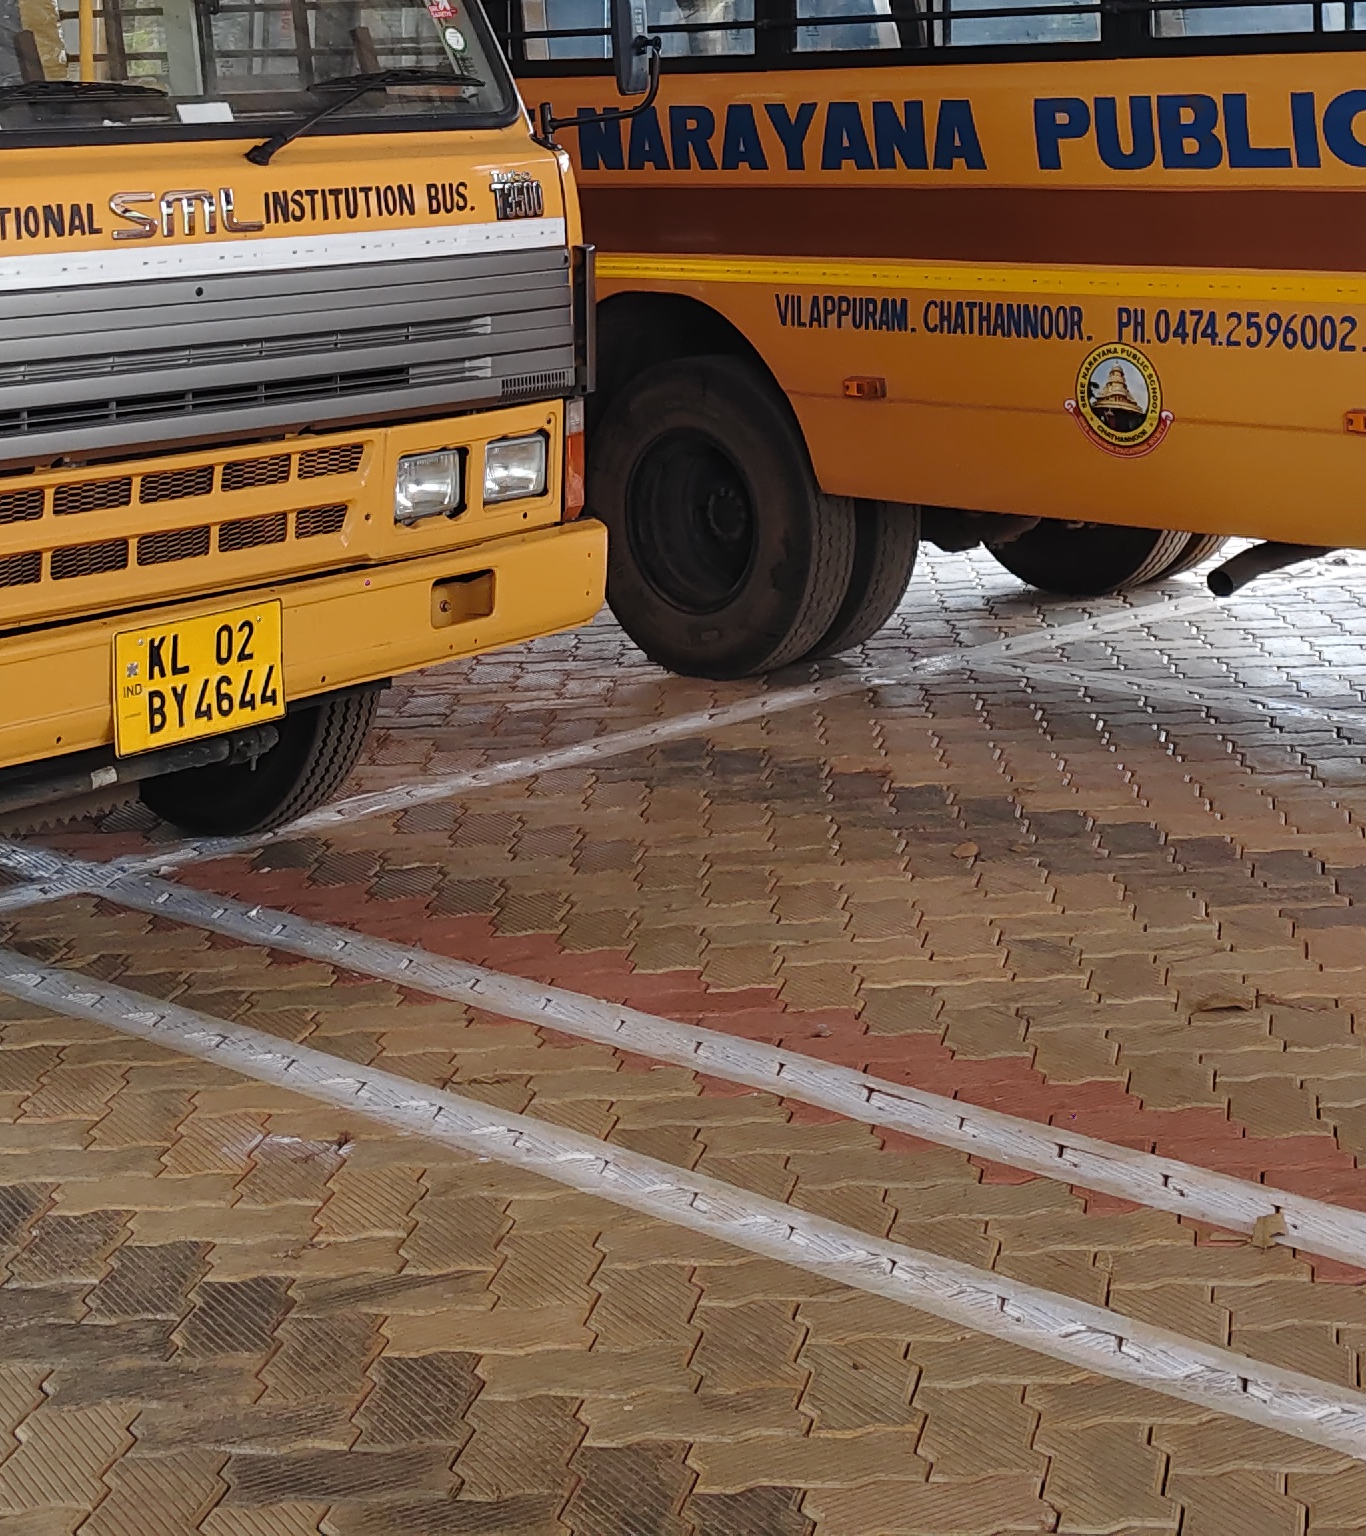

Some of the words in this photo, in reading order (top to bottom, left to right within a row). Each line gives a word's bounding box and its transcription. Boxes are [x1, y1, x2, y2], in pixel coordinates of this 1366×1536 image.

[576, 98, 987, 171] NARAYANA
[264, 183, 415, 224] INSTITUTION
[426, 181, 476, 215] BUS.
[490, 181, 544, 220] T3500
[775, 293, 917, 333] VILAPPURAM.
[924, 299, 1093, 342] CHATHANNOOR.
[1083, 347, 1120, 380] NARAYANA
[1120, 347, 1150, 373] PUBLIC
[1146, 373, 1159, 415] SCHOOL
[148, 634, 190, 681] KL
[215, 619, 254, 665] 02
[123, 683, 143, 698] IND
[148, 665, 278, 734] BY4644
